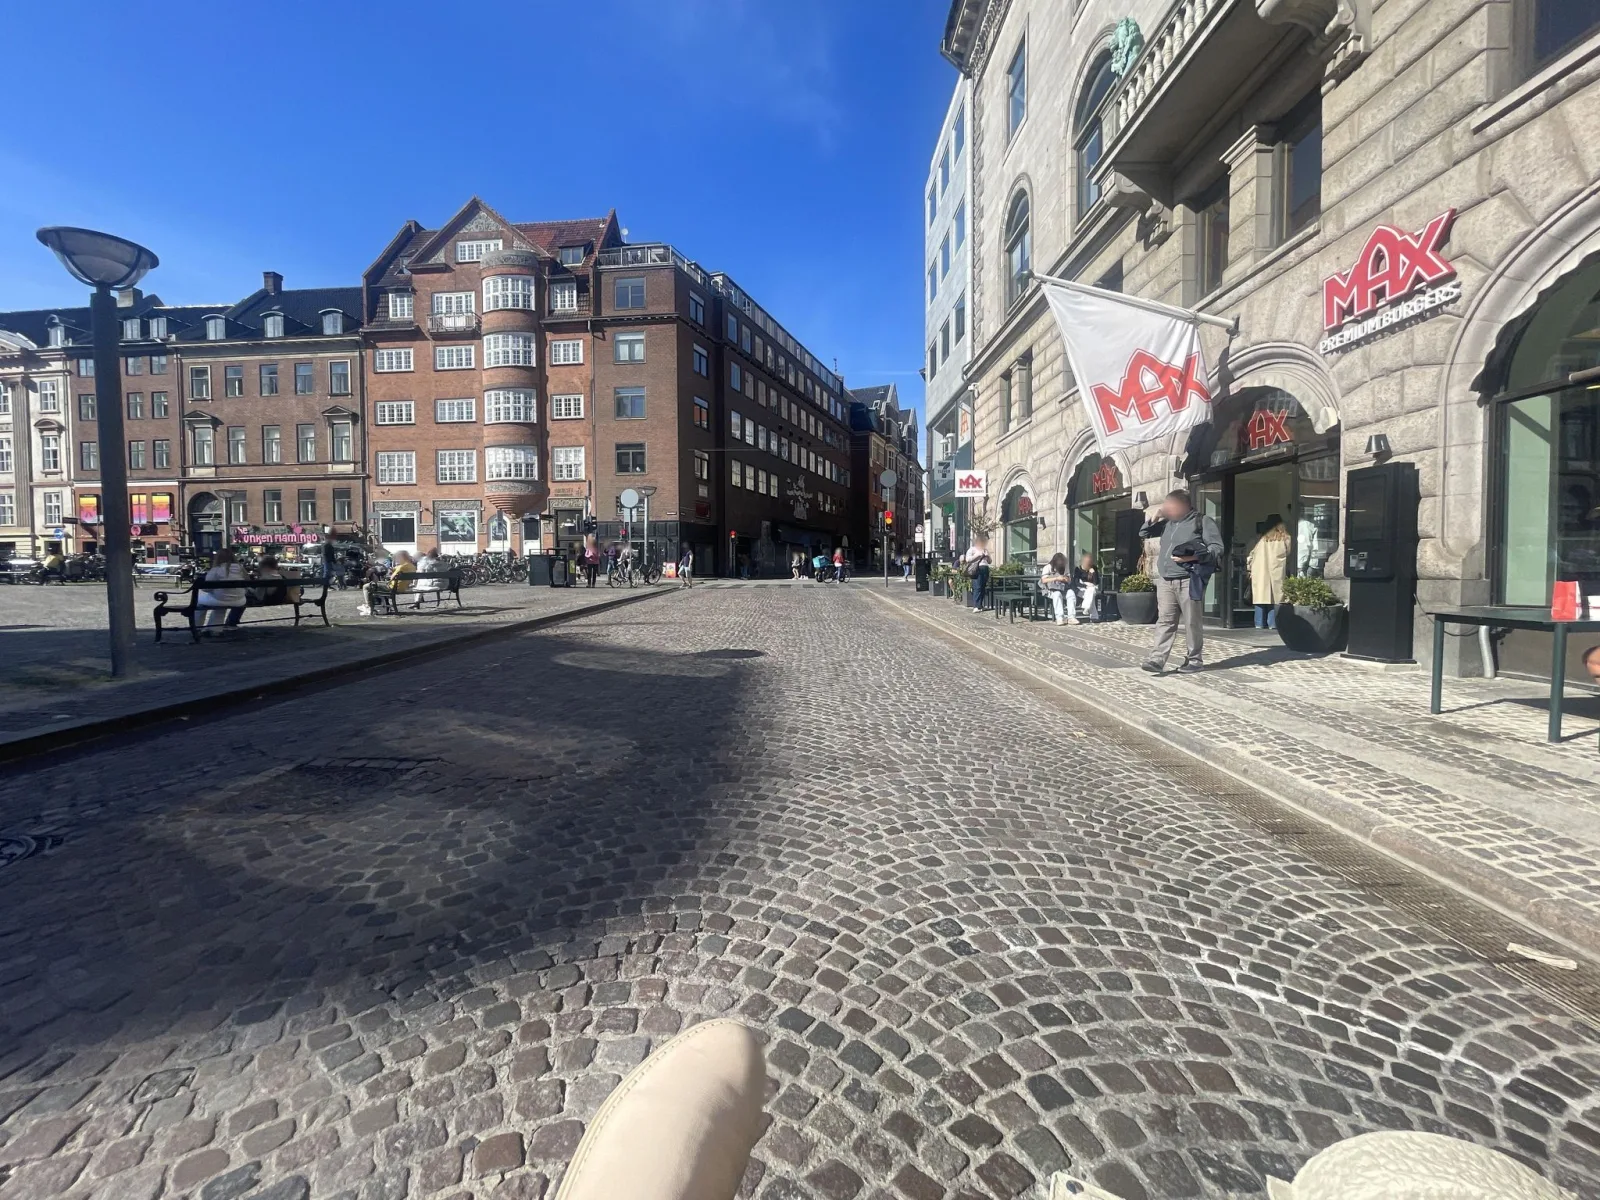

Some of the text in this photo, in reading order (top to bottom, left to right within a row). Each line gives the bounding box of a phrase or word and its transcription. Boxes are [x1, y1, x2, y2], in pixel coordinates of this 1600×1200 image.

[1323, 208, 1457, 332] MAX
[1320, 281, 1461, 354] PREMIUM BURGERS
[1090, 348, 1211, 437] MAX
[938, 461, 951, 479] 7
[959, 474, 983, 489] MAX
[1093, 463, 1117, 494] MAX
[233, 532, 273, 545] unken
